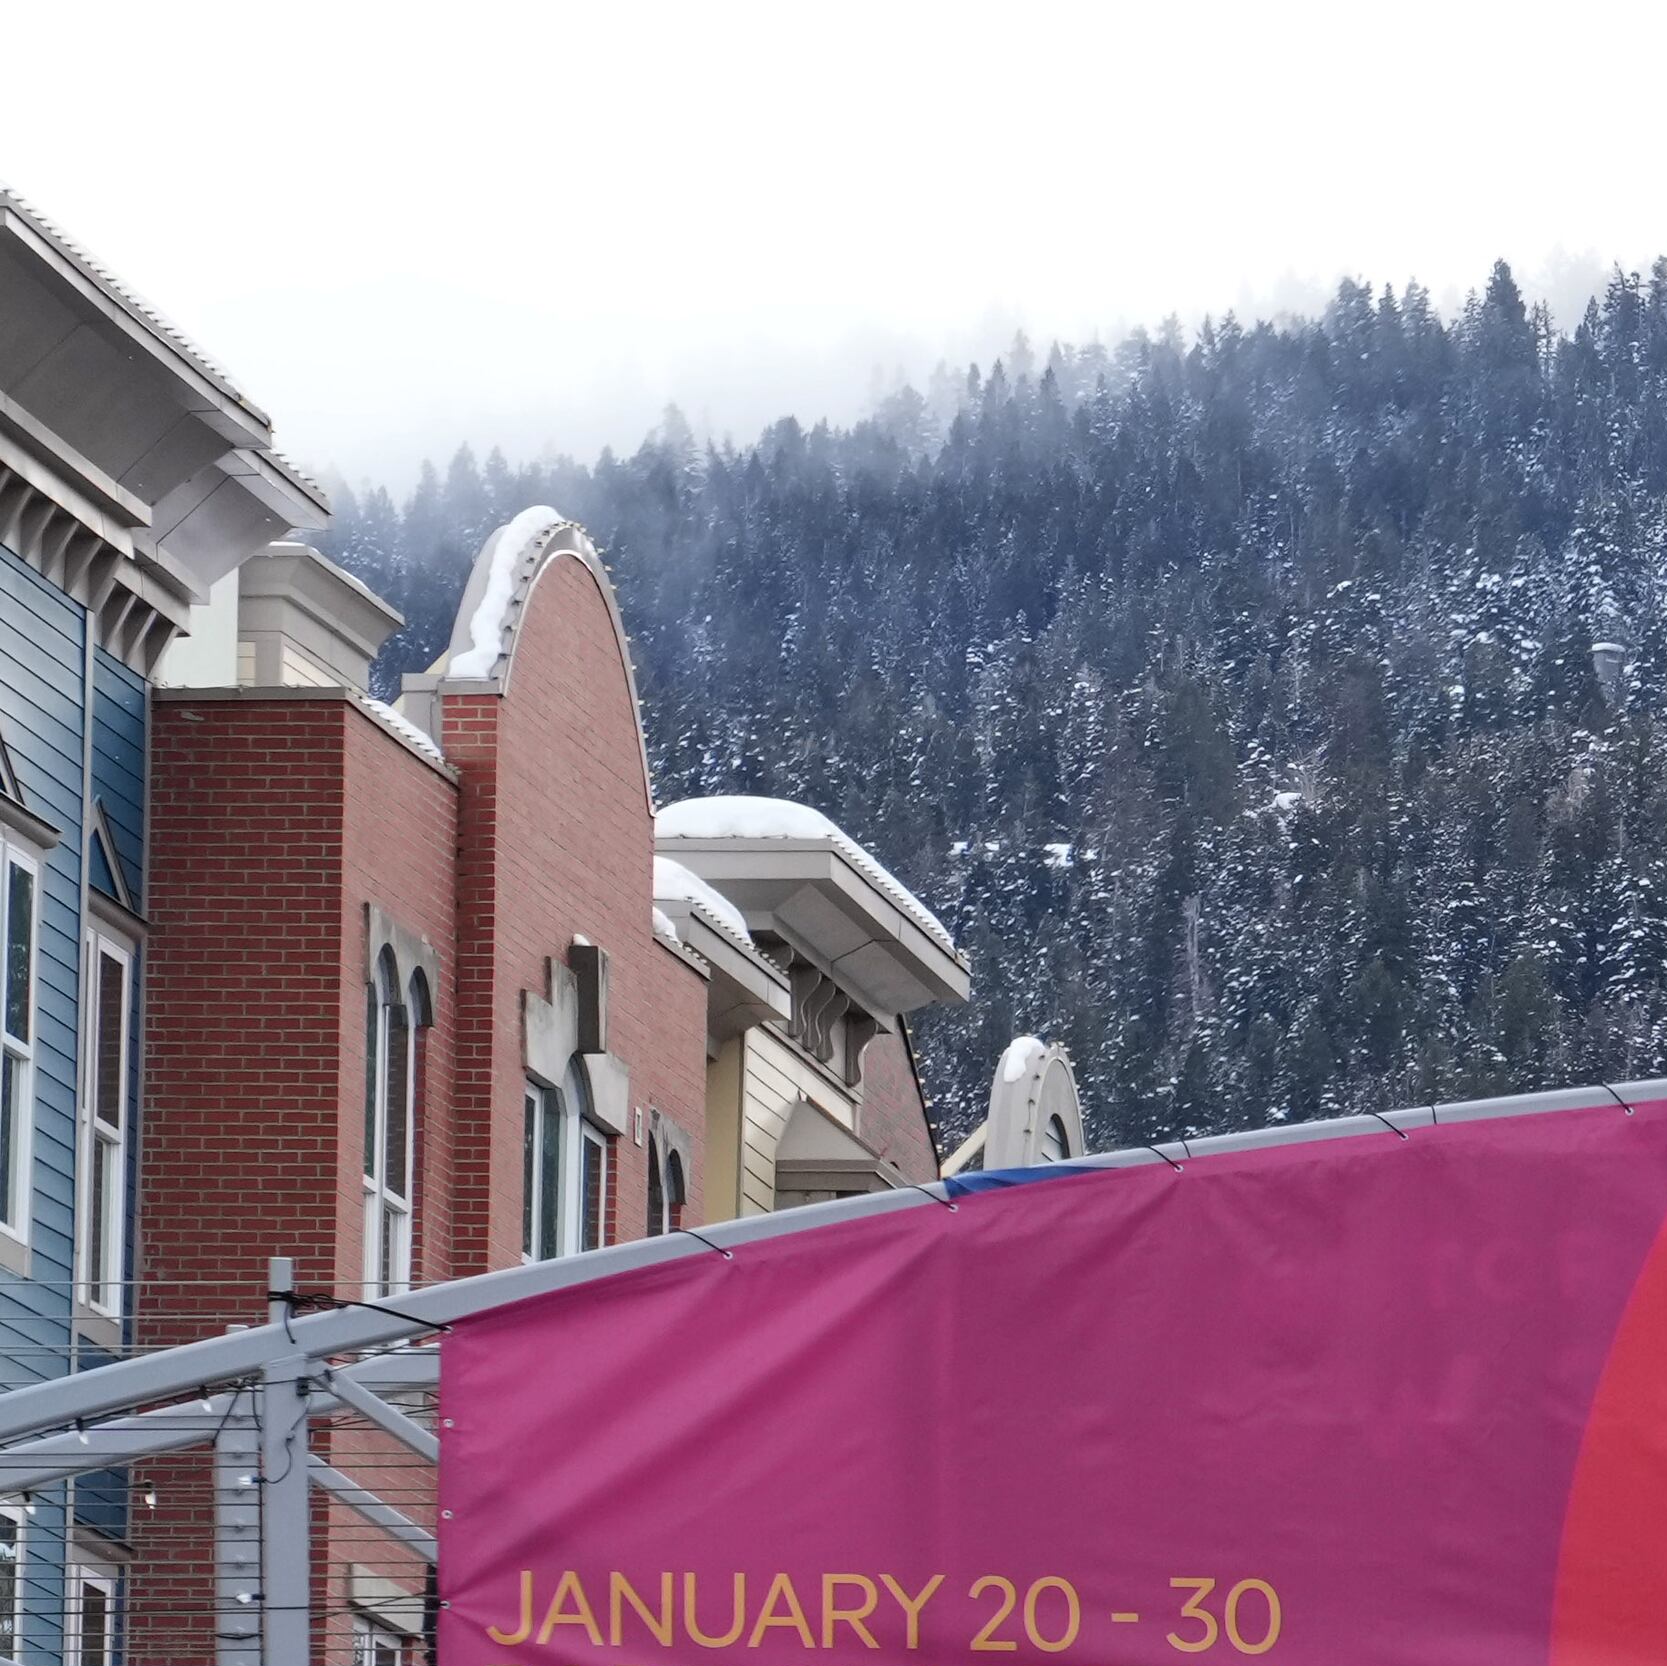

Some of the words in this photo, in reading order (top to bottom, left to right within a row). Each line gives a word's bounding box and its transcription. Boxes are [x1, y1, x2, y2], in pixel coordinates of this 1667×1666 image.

[486, 1571, 944, 1649] JANUARY
[969, 1575, 1082, 1653] 20
[1167, 1577, 1281, 1655] 30
